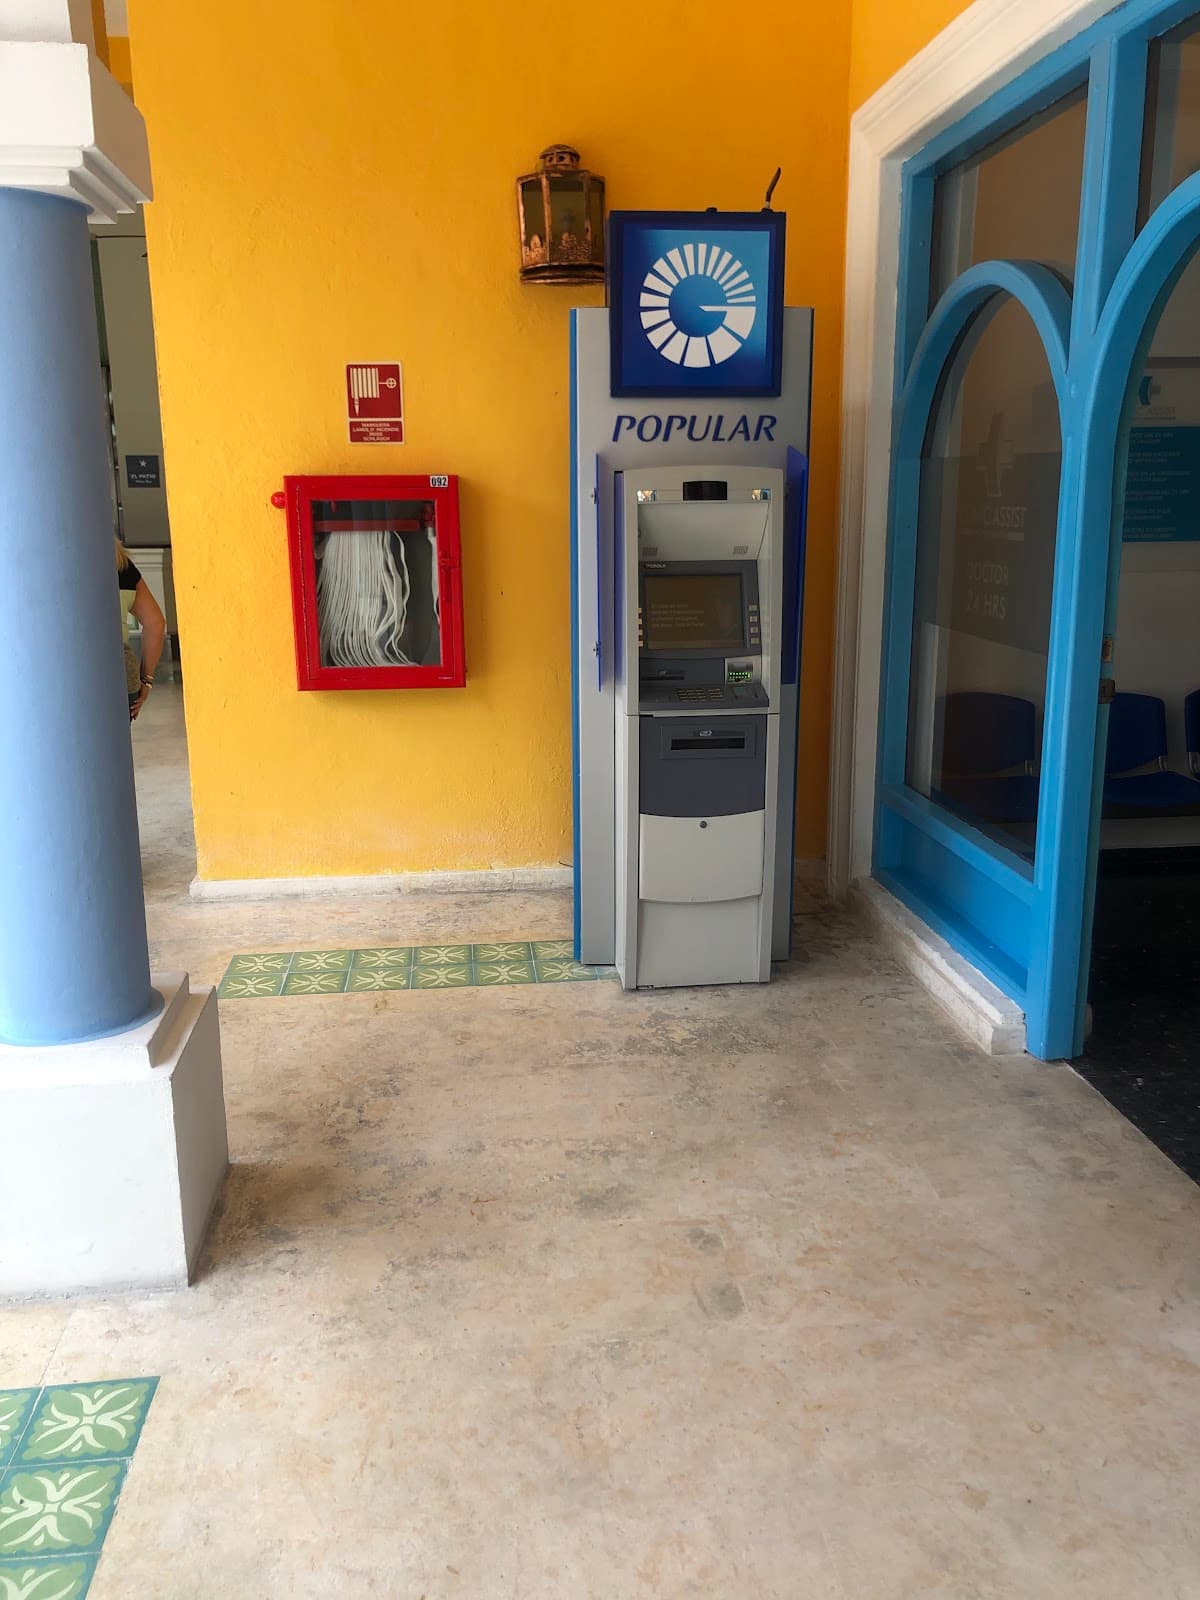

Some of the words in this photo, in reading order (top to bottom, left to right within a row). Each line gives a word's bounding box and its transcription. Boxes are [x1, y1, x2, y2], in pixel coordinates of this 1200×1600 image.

[611, 414, 778, 442] POPULAR
[431, 477, 447, 486] 092
[983, 591, 1008, 620] HRS
